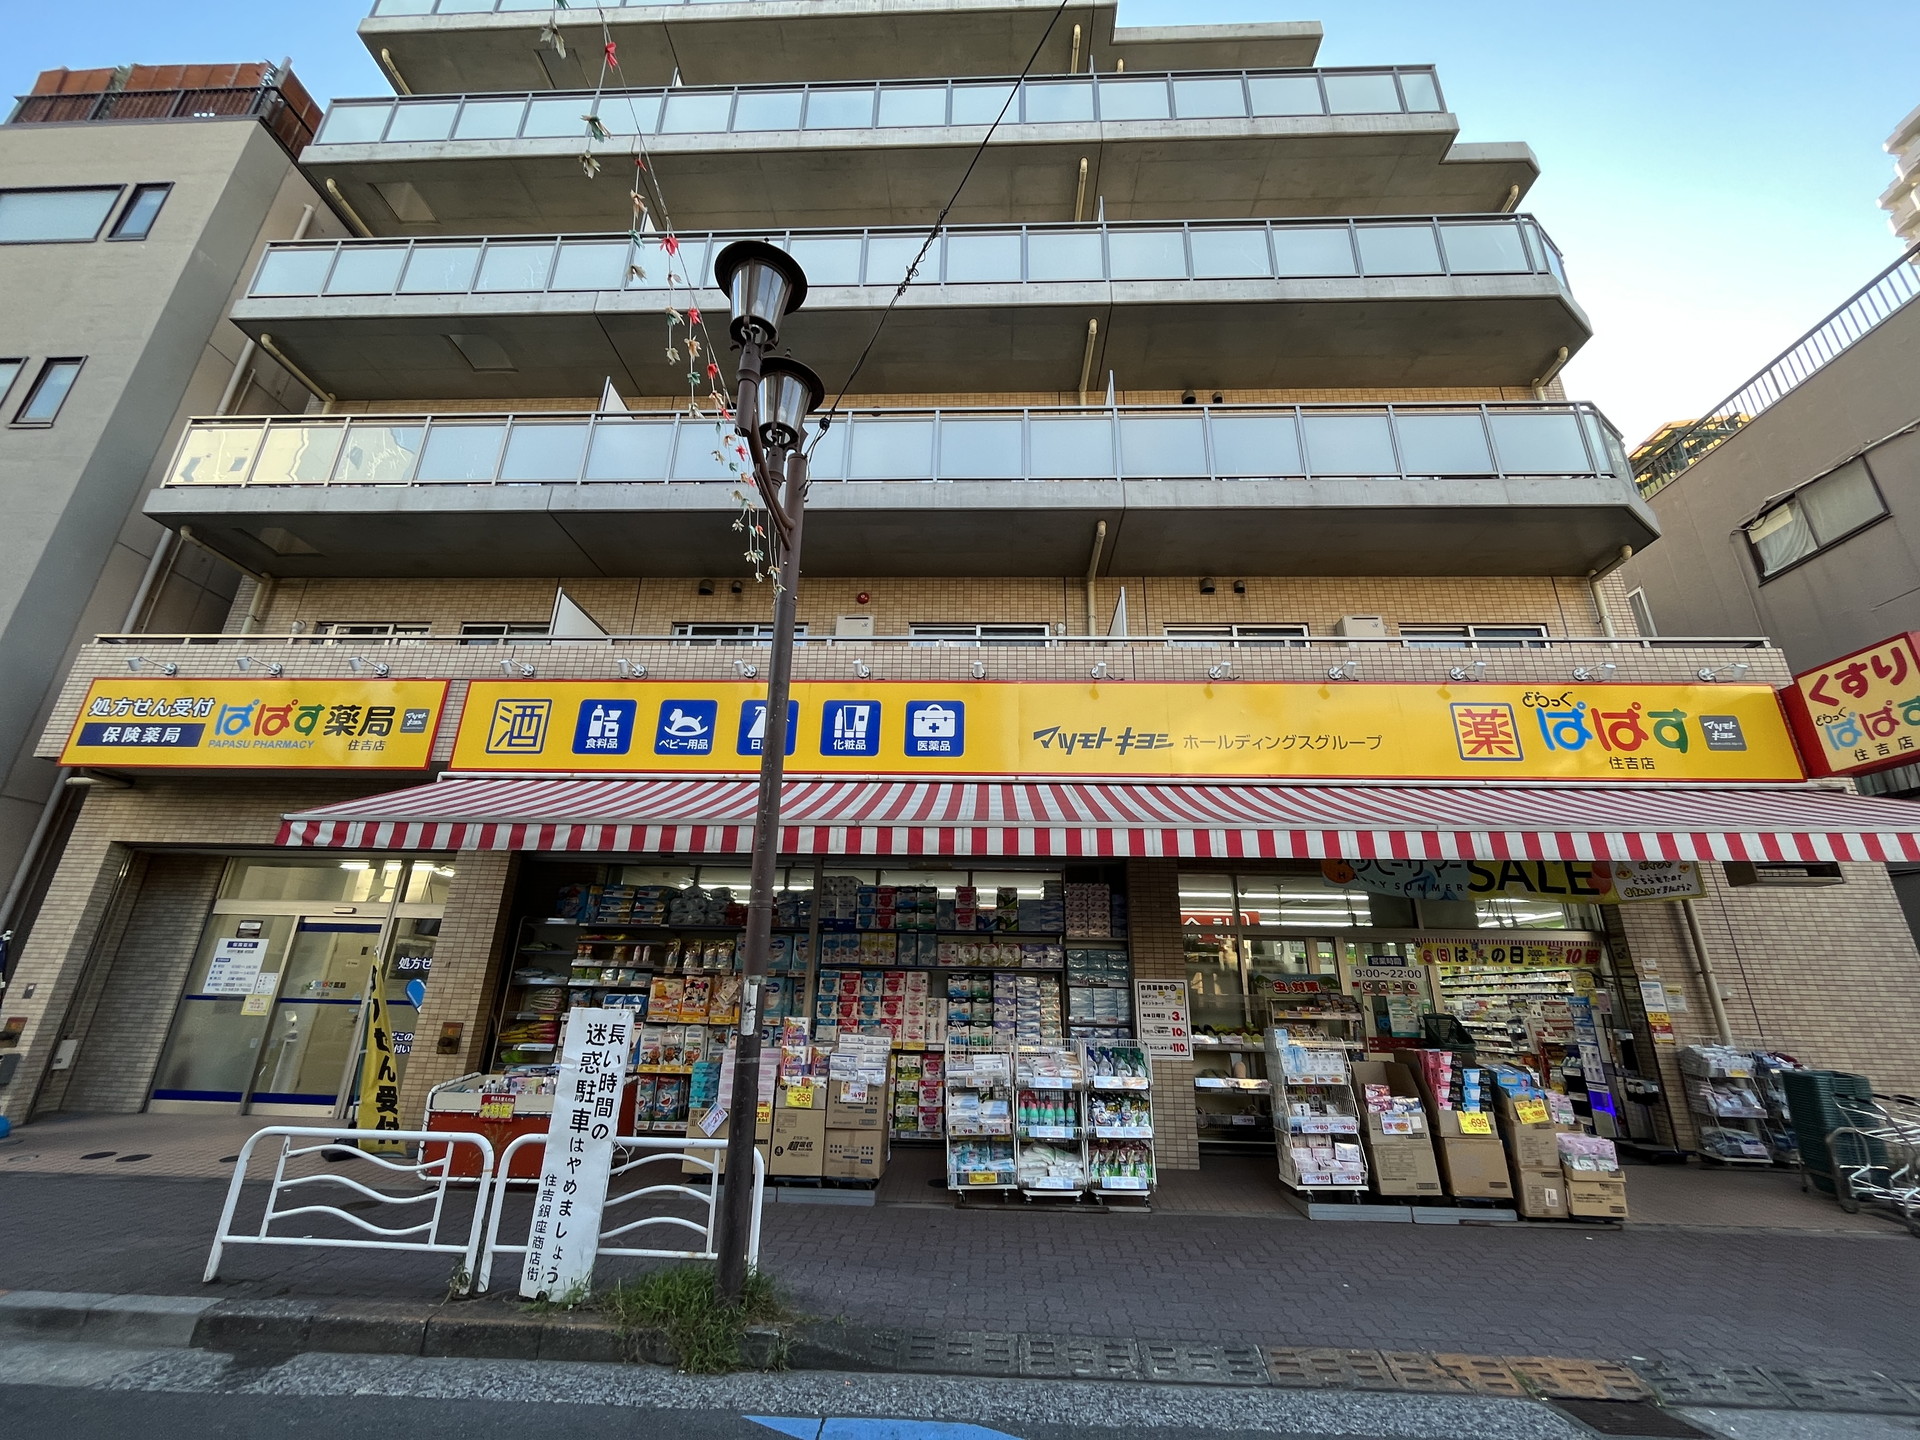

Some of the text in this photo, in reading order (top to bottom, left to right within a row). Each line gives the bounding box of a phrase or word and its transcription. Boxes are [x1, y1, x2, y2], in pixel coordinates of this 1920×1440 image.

[1809, 647, 1907, 706] くすり
[88, 697, 215, 718] 処方せん受付
[1522, 690, 1573, 708] どらっぐ
[215, 699, 395, 737] ぱぱす薬局
[491, 704, 546, 748] 酒
[1537, 701, 1690, 754] ぱぱす
[102, 726, 181, 744] 保険薬局
[207, 739, 315, 750] PAPASU PHARMACY
[585, 737, 618, 749] 食料品
[658, 737, 708, 750] ベビー用品
[832, 738, 866, 751] 化粧品
[1033, 725, 1383, 755] マツモトキヨシ ホールディングスグループ
[1457, 707, 1514, 756] 薬
[347, 739, 386, 752] 住吉店
[917, 739, 951, 752] 医薬品
[1854, 736, 1914, 762] 住吉店
[1609, 756, 1656, 771] 住吉店
[1395, 882, 1463, 892] SUMMER
[1467, 861, 1600, 895] SALE
[371, 965, 400, 1145] せん受付
[591, 1023, 626, 1140] 長い時間の
[545, 1022, 608, 1284] 迷惑駐車はやめましょう
[526, 1173, 557, 1282] 住吉銀座商店街
